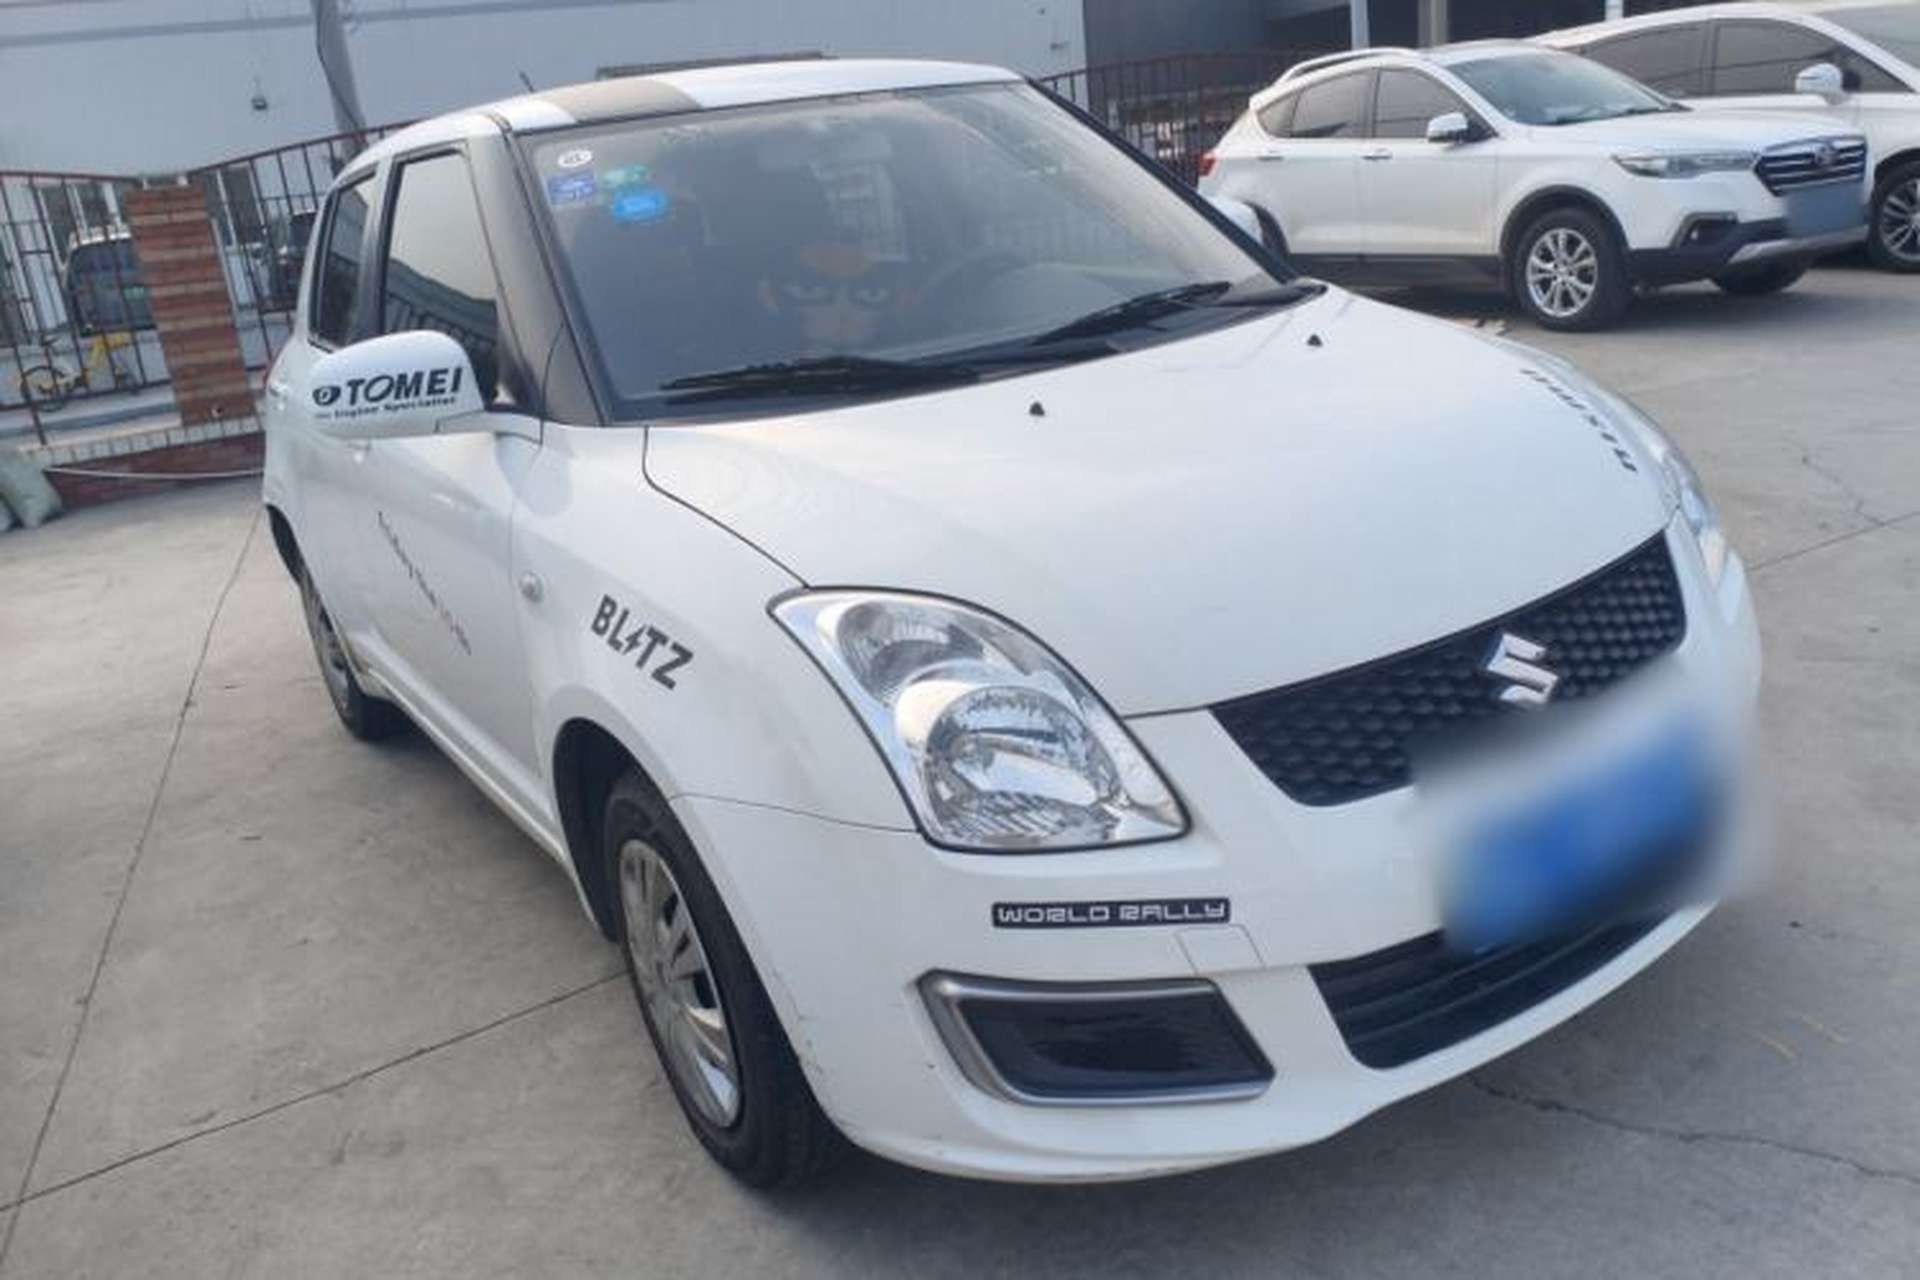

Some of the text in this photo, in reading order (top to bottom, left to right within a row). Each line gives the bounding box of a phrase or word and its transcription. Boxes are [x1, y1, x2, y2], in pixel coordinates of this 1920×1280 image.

[346, 366, 463, 406] TOMEI
[998, 902, 1225, 923] WORLD RALLY
